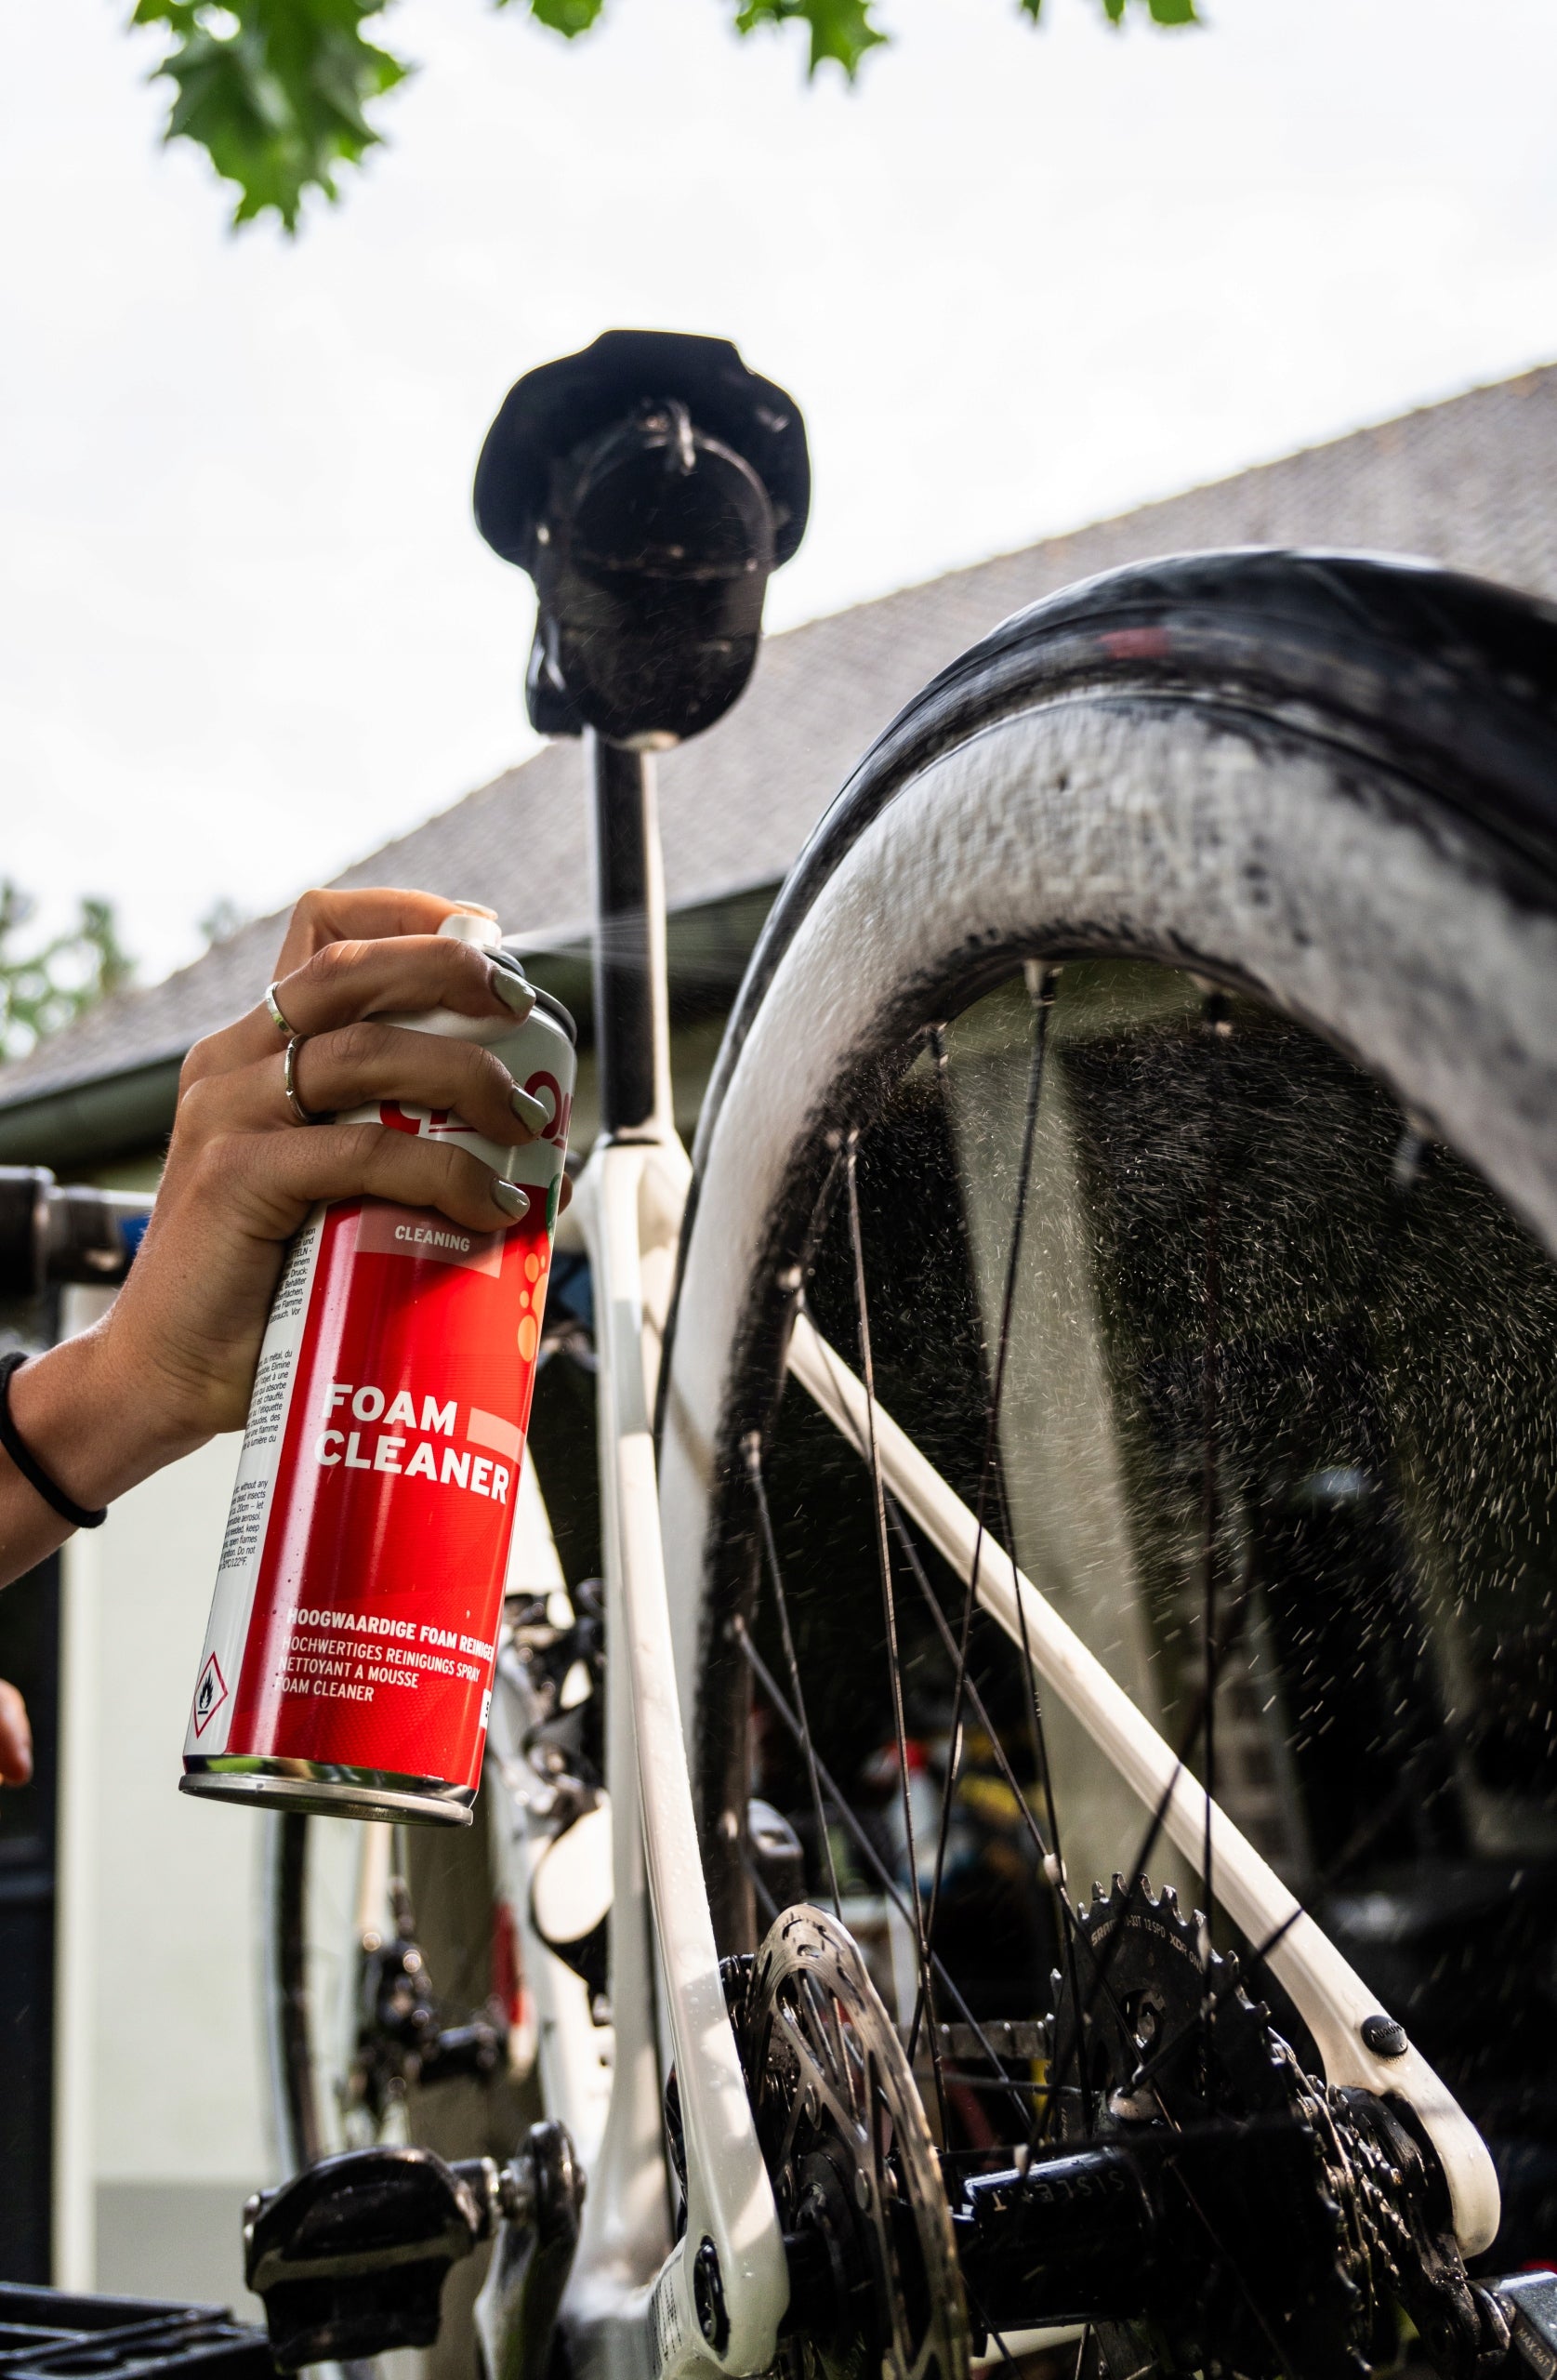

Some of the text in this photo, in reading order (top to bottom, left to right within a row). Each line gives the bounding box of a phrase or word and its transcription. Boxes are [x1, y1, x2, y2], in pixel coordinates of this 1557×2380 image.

[394, 1224, 470, 1251] CLEANING
[294, 1257, 310, 1267] einem
[266, 1381, 287, 1392] absorbe
[322, 1383, 458, 1436] FOAM
[258, 1425, 278, 1434] flamme
[314, 1429, 509, 1505] CLEANER
[257, 1480, 268, 1488] any
[247, 1491, 265, 1500] insects
[245, 1524, 260, 1534] keep
[240, 1535, 257, 1545] flames
[237, 1547, 245, 1555] Do
[287, 1607, 495, 1663] HOOGWAARDIGE FOAM REINIGE
[282, 1635, 482, 1683] HOCHWERTIGES REINIGUNGS SPRAY
[280, 1656, 420, 1689] NETTOYANT A MOUSSE
[274, 1676, 375, 1702] FOAM CLEANER
